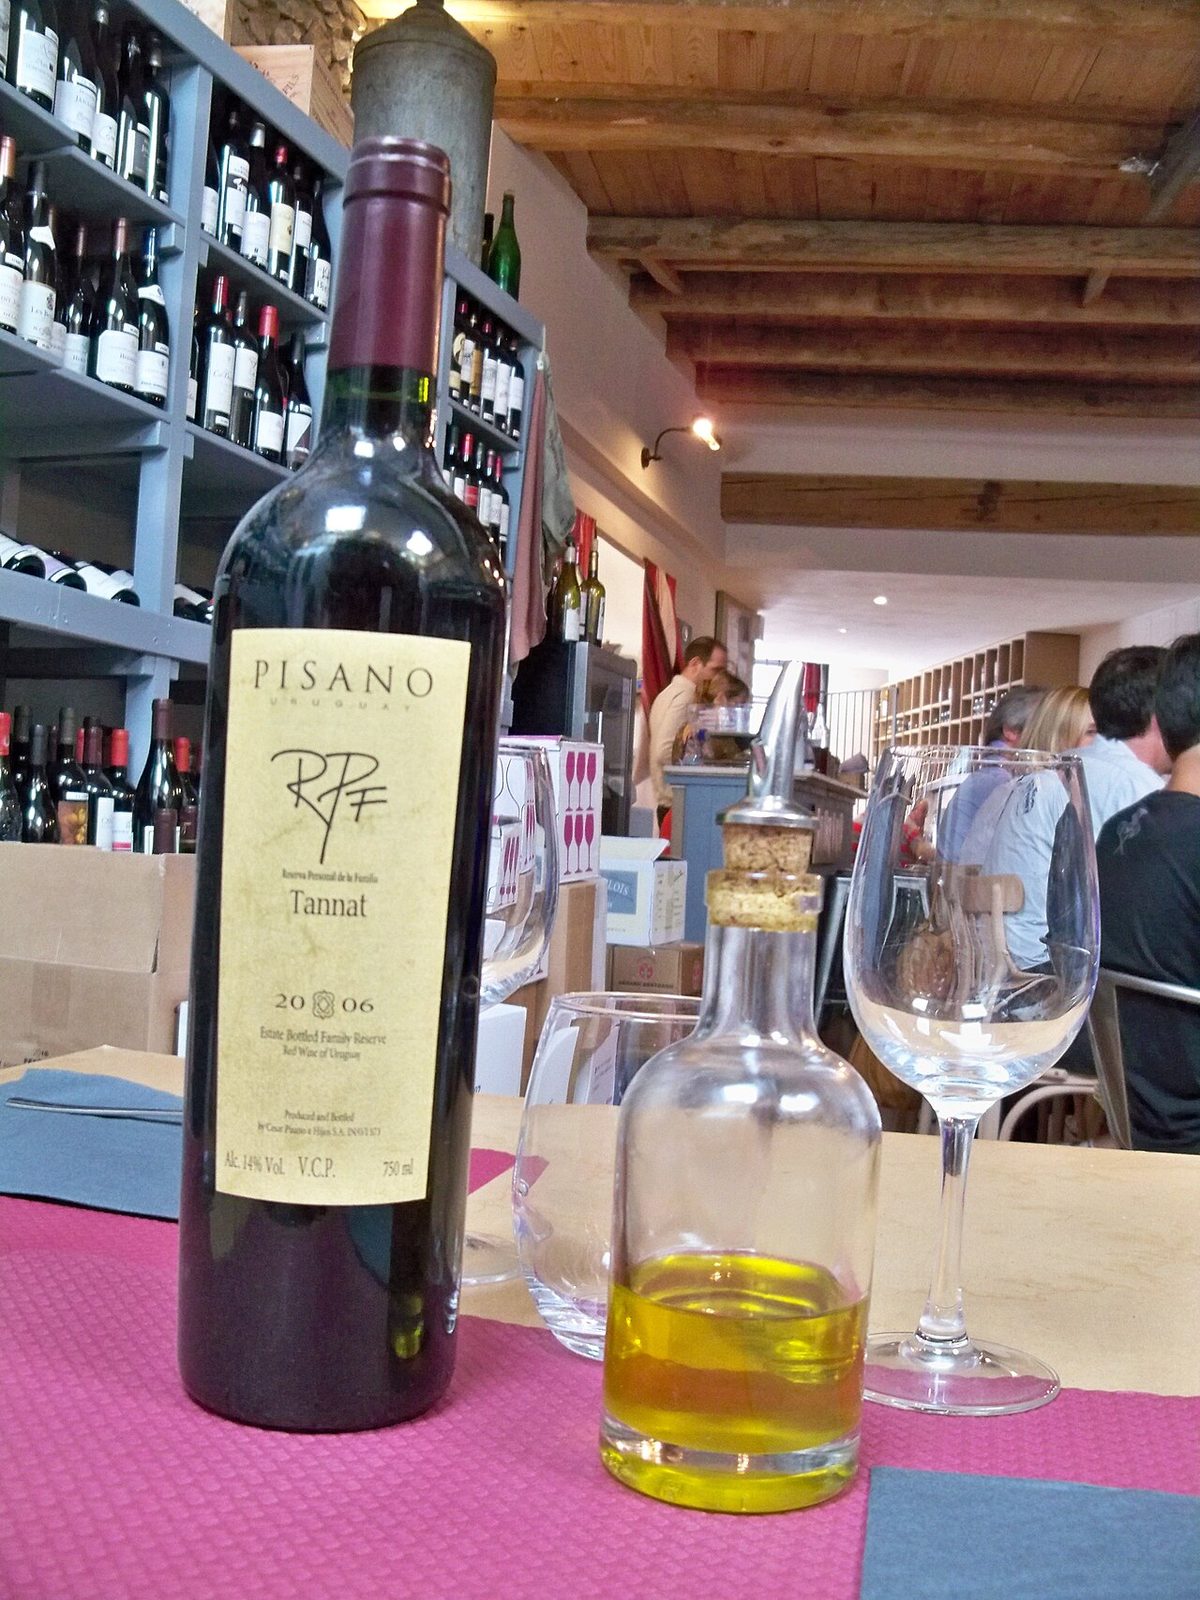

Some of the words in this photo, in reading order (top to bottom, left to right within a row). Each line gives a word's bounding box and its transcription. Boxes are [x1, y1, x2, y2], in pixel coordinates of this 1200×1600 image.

[254, 659, 433, 698] PISANO
[269, 697, 411, 712] URUGUAY
[290, 889, 367, 917] Tannat
[275, 993, 305, 1011] 20
[342, 996, 375, 1014] 06
[259, 1026, 284, 1041] Estate
[286, 1028, 319, 1043] Bottled
[320, 1031, 352, 1047] Family
[353, 1032, 387, 1045] Reserve
[298, 1045, 318, 1058] Wine
[242, 1154, 264, 1173] 14%
[265, 1156, 286, 1176] Vol.
[298, 1155, 337, 1178] V.C.P.
[382, 1160, 400, 1177] 750
[401, 1158, 414, 1176] ml
